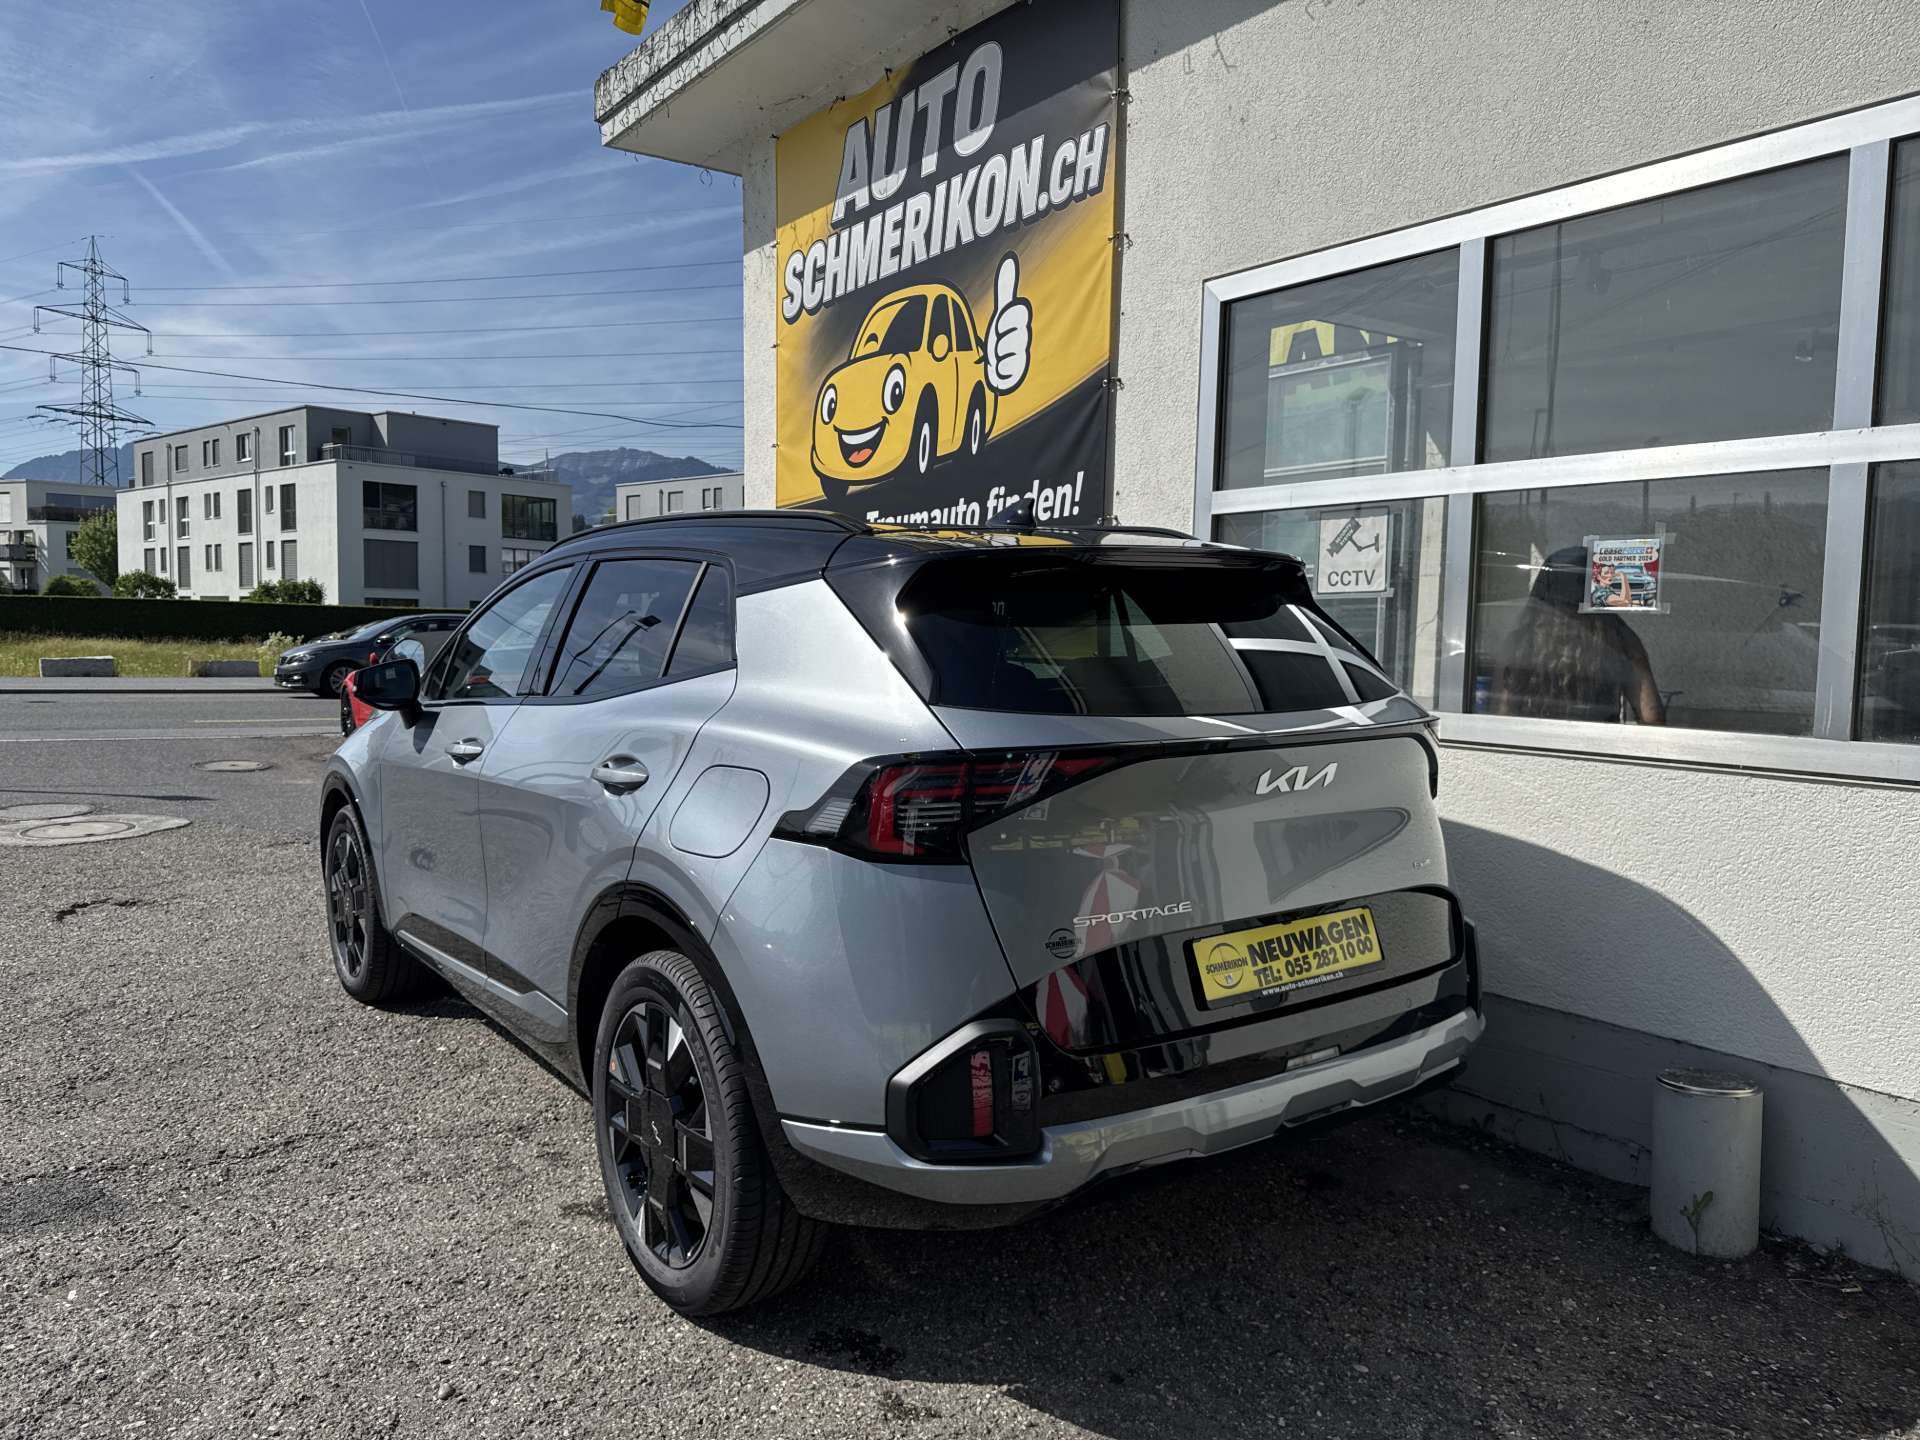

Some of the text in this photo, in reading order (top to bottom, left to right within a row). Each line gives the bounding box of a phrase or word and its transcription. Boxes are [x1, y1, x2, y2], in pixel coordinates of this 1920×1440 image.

[832, 41, 1002, 222] AUTO
[783, 123, 1109, 322] SCHMERIKON.CH
[1327, 569, 1376, 587] CCTV
[1255, 762, 1339, 795] KIA
[1072, 901, 1193, 928] SPORTAGE
[1246, 913, 1370, 967] NEUWAGEN
[1253, 935, 1373, 987] TEL: 055 282 10 00
[1205, 956, 1248, 974] SCHMERIKON
